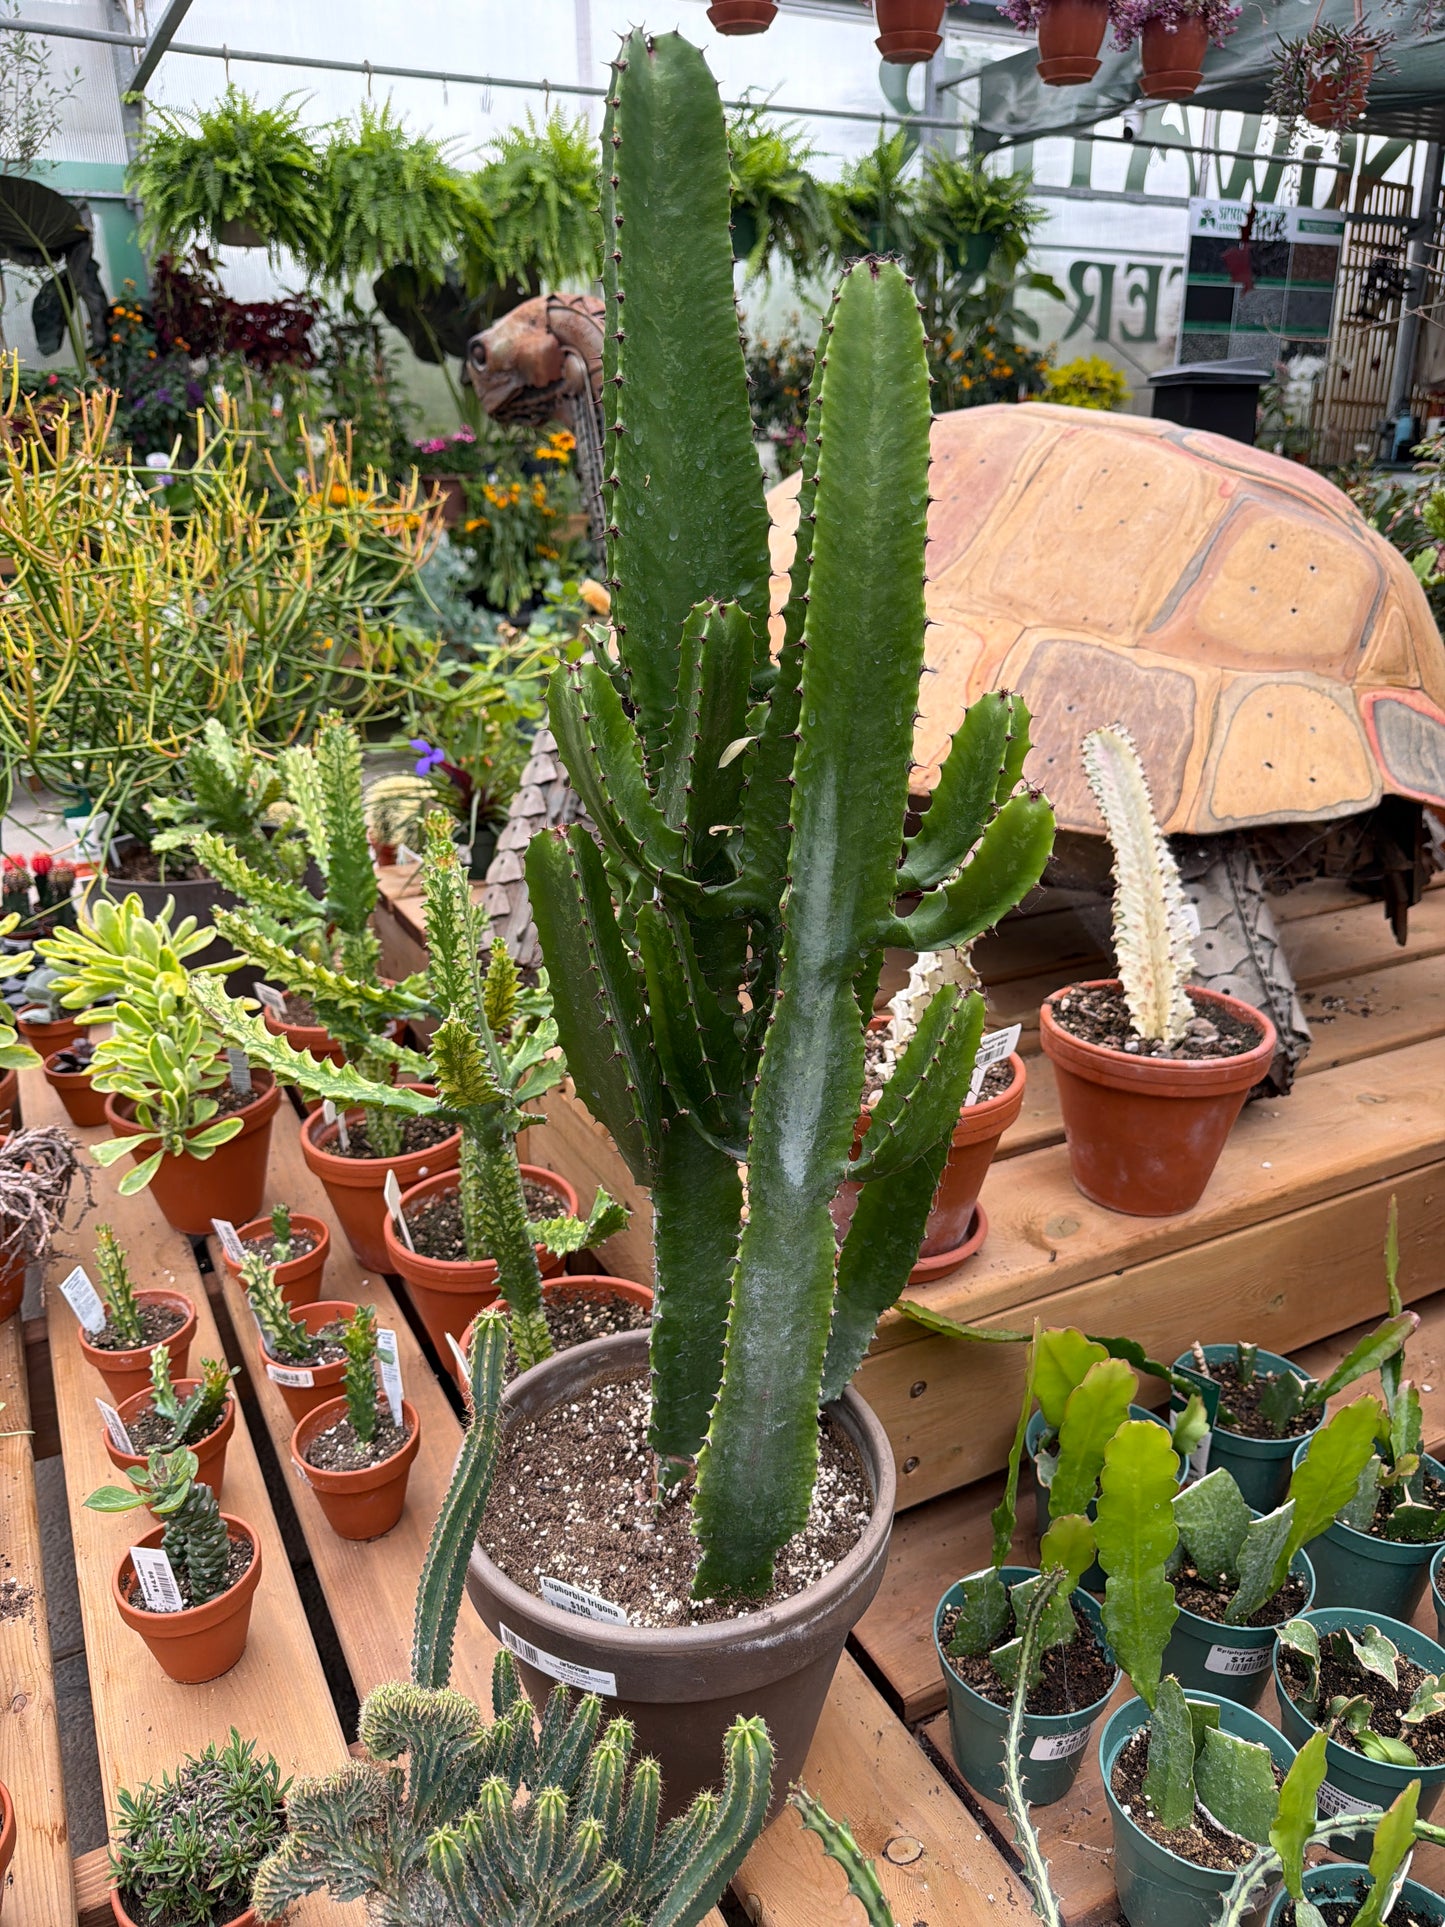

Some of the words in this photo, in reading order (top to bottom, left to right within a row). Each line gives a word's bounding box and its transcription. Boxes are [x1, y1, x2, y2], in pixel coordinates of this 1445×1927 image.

[543, 1579, 586, 1603] Euphorbia
[587, 1598, 619, 1618] trigona
[1230, 1652, 1270, 1663] $14.99
